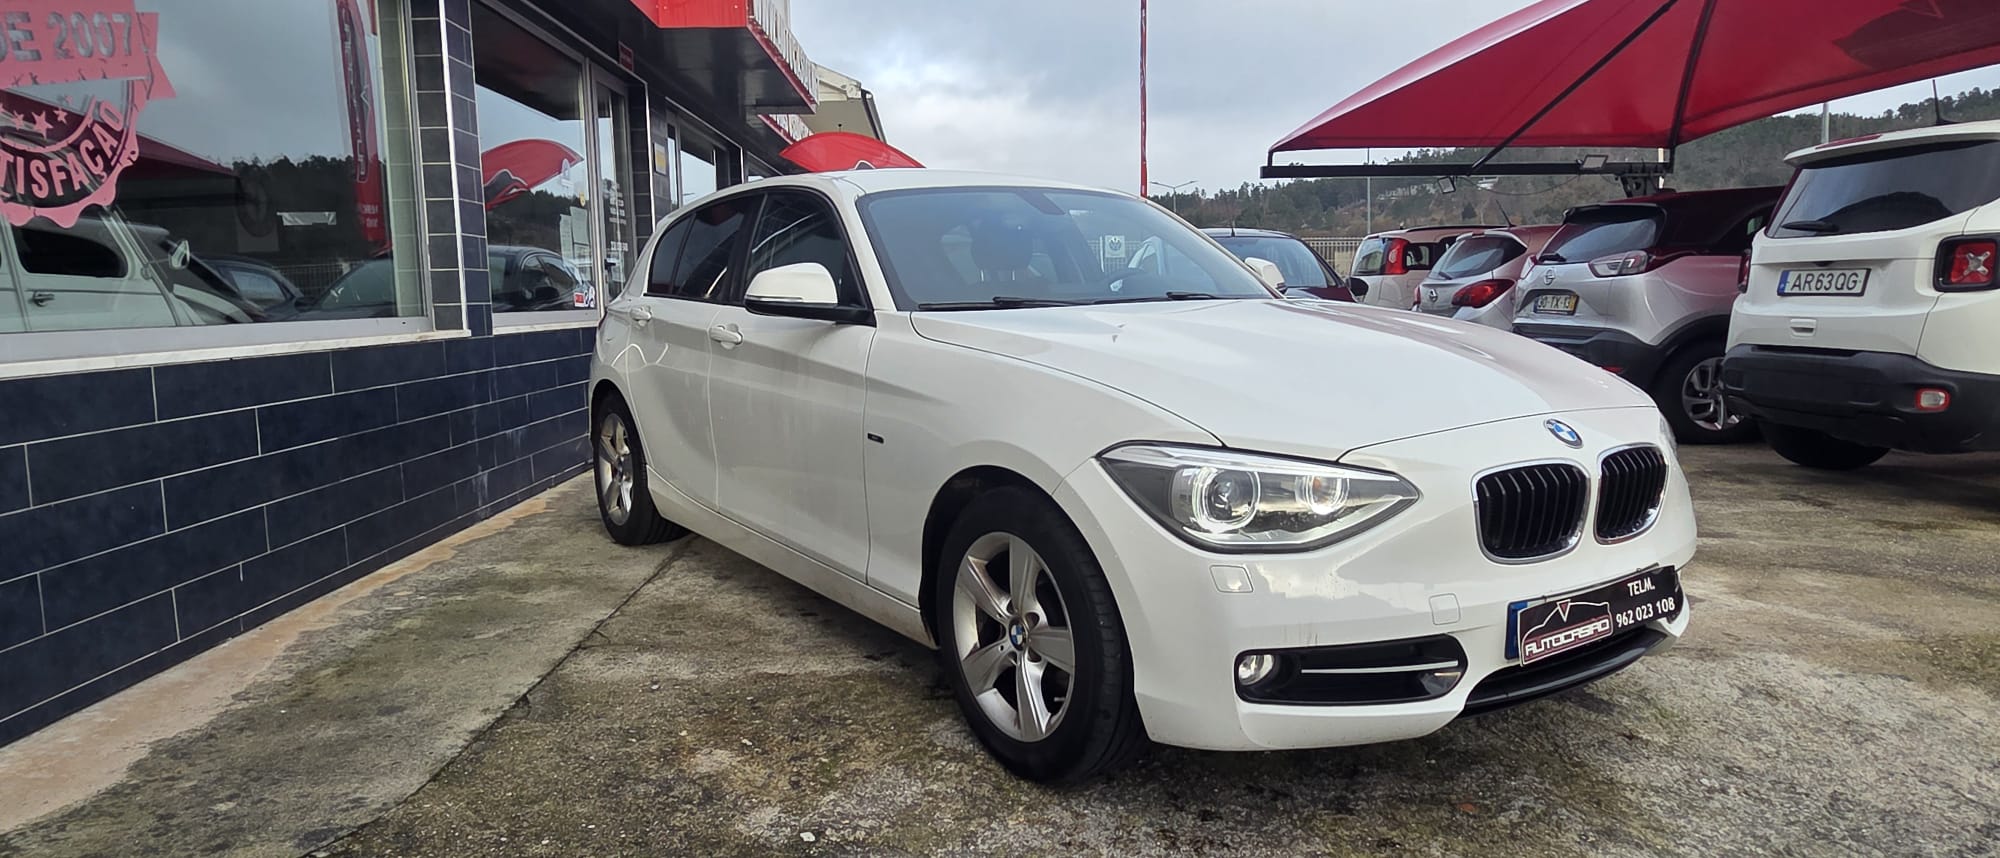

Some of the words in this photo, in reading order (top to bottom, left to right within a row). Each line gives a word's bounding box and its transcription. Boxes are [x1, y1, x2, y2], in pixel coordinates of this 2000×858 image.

[47, 12, 132, 59] 2007
[1790, 272, 1860, 291] AR63QG
[1627, 577, 1656, 597] TELM.
[1616, 610, 1635, 628] 962
[1635, 603, 1654, 622] 023
[1656, 597, 1676, 615] 108
